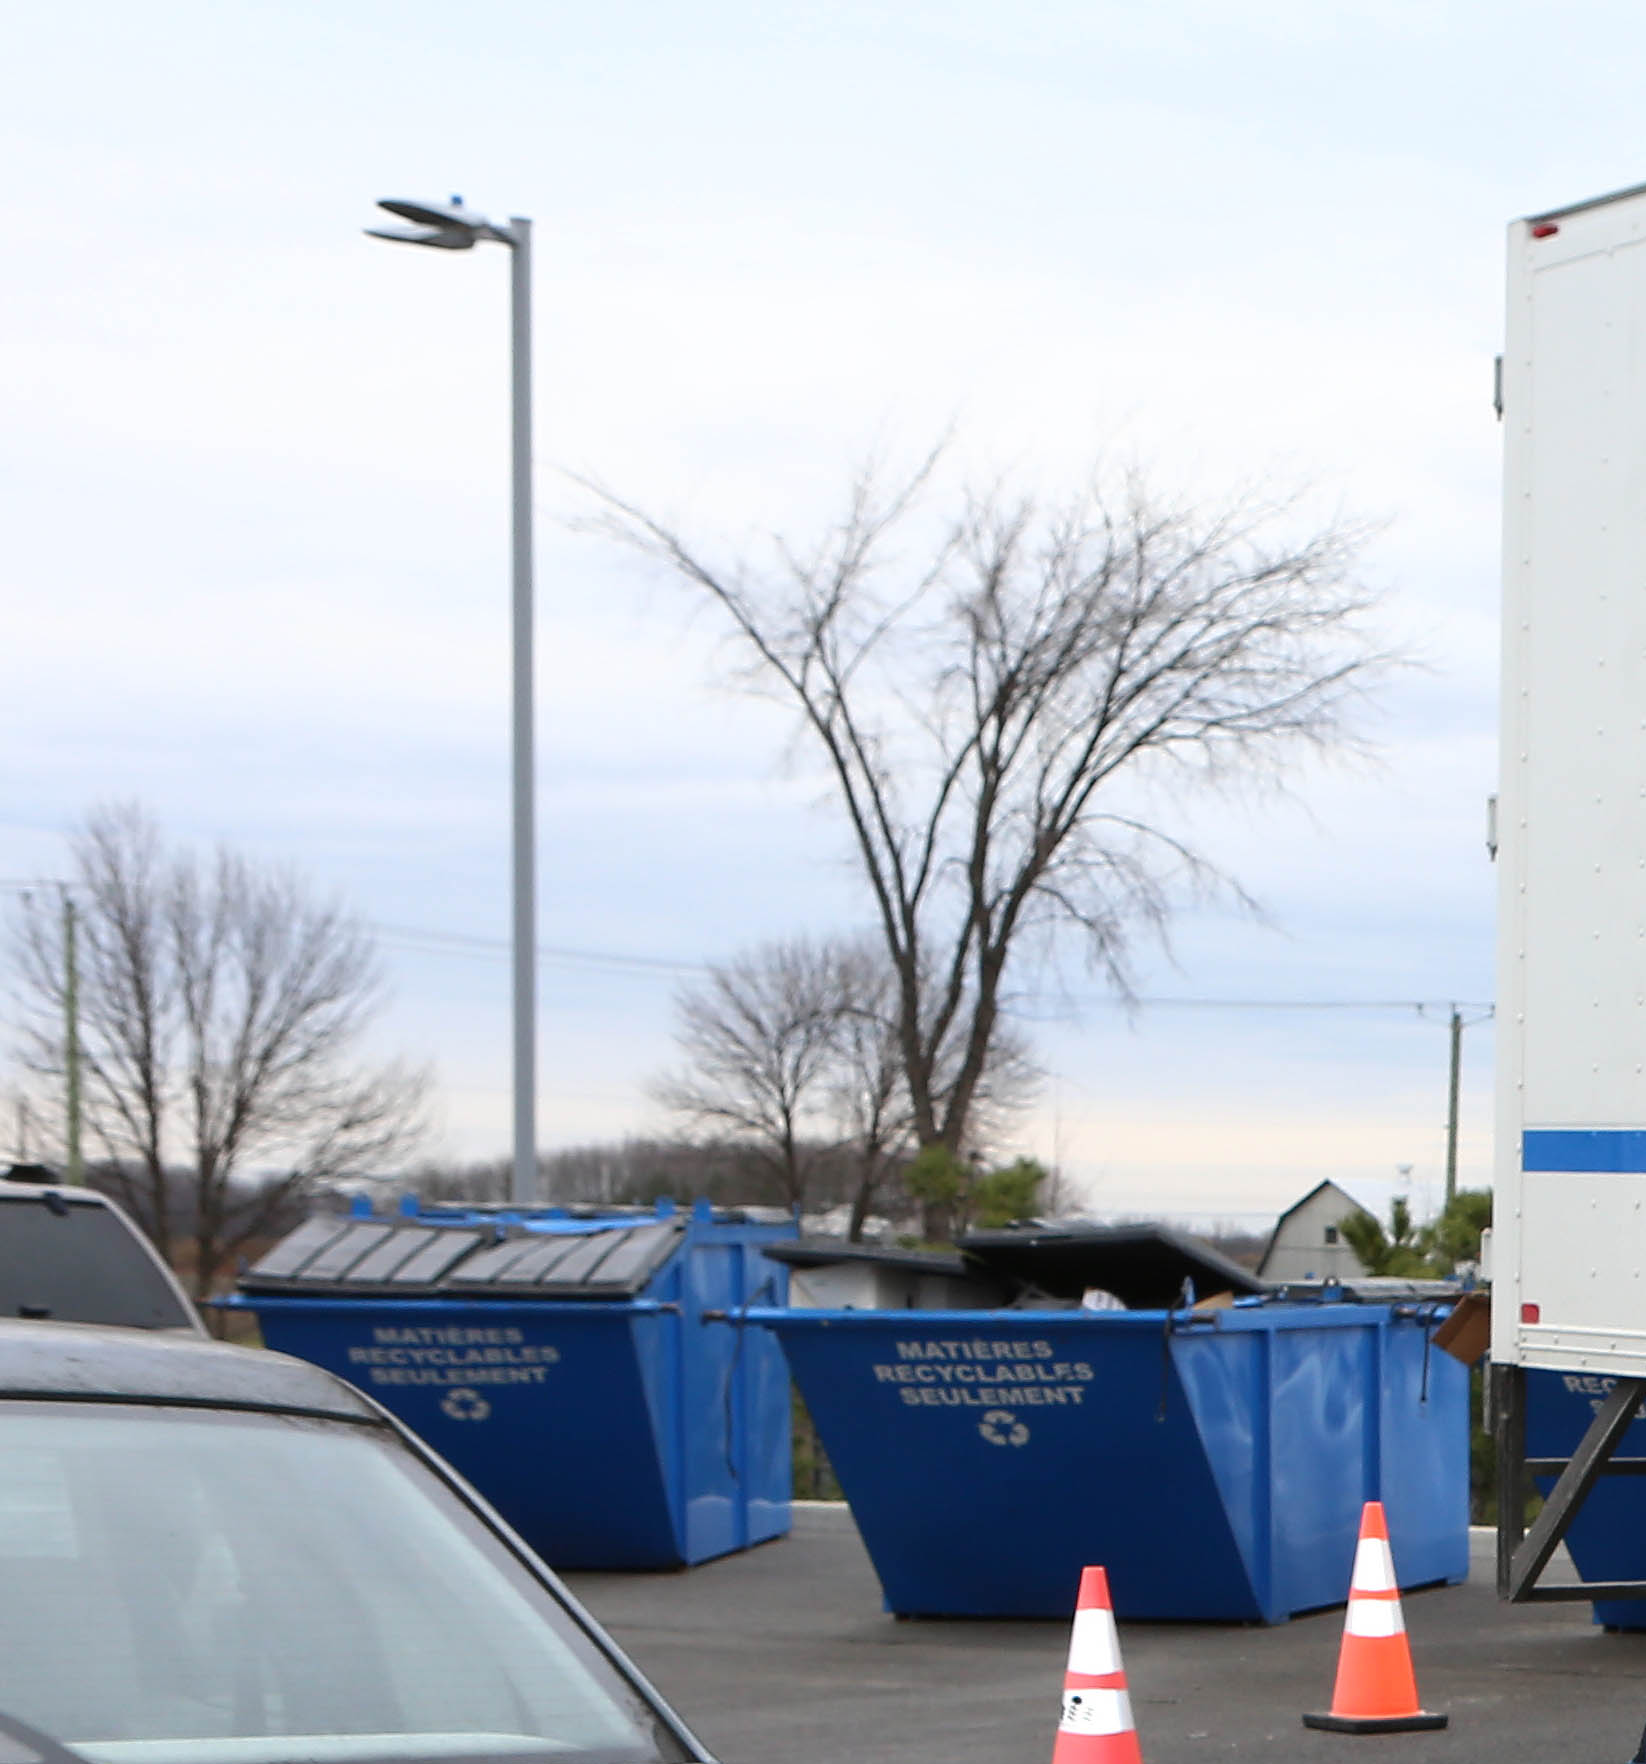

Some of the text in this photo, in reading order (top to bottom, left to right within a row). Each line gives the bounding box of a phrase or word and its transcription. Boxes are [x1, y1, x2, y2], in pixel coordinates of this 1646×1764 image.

[349, 1346, 561, 1365] RECYCLABLES
[370, 1366, 549, 1385] SEULEMENT
[873, 1362, 1094, 1383] RECYCLABLES
[899, 1386, 1084, 1406] SEULEMENT
